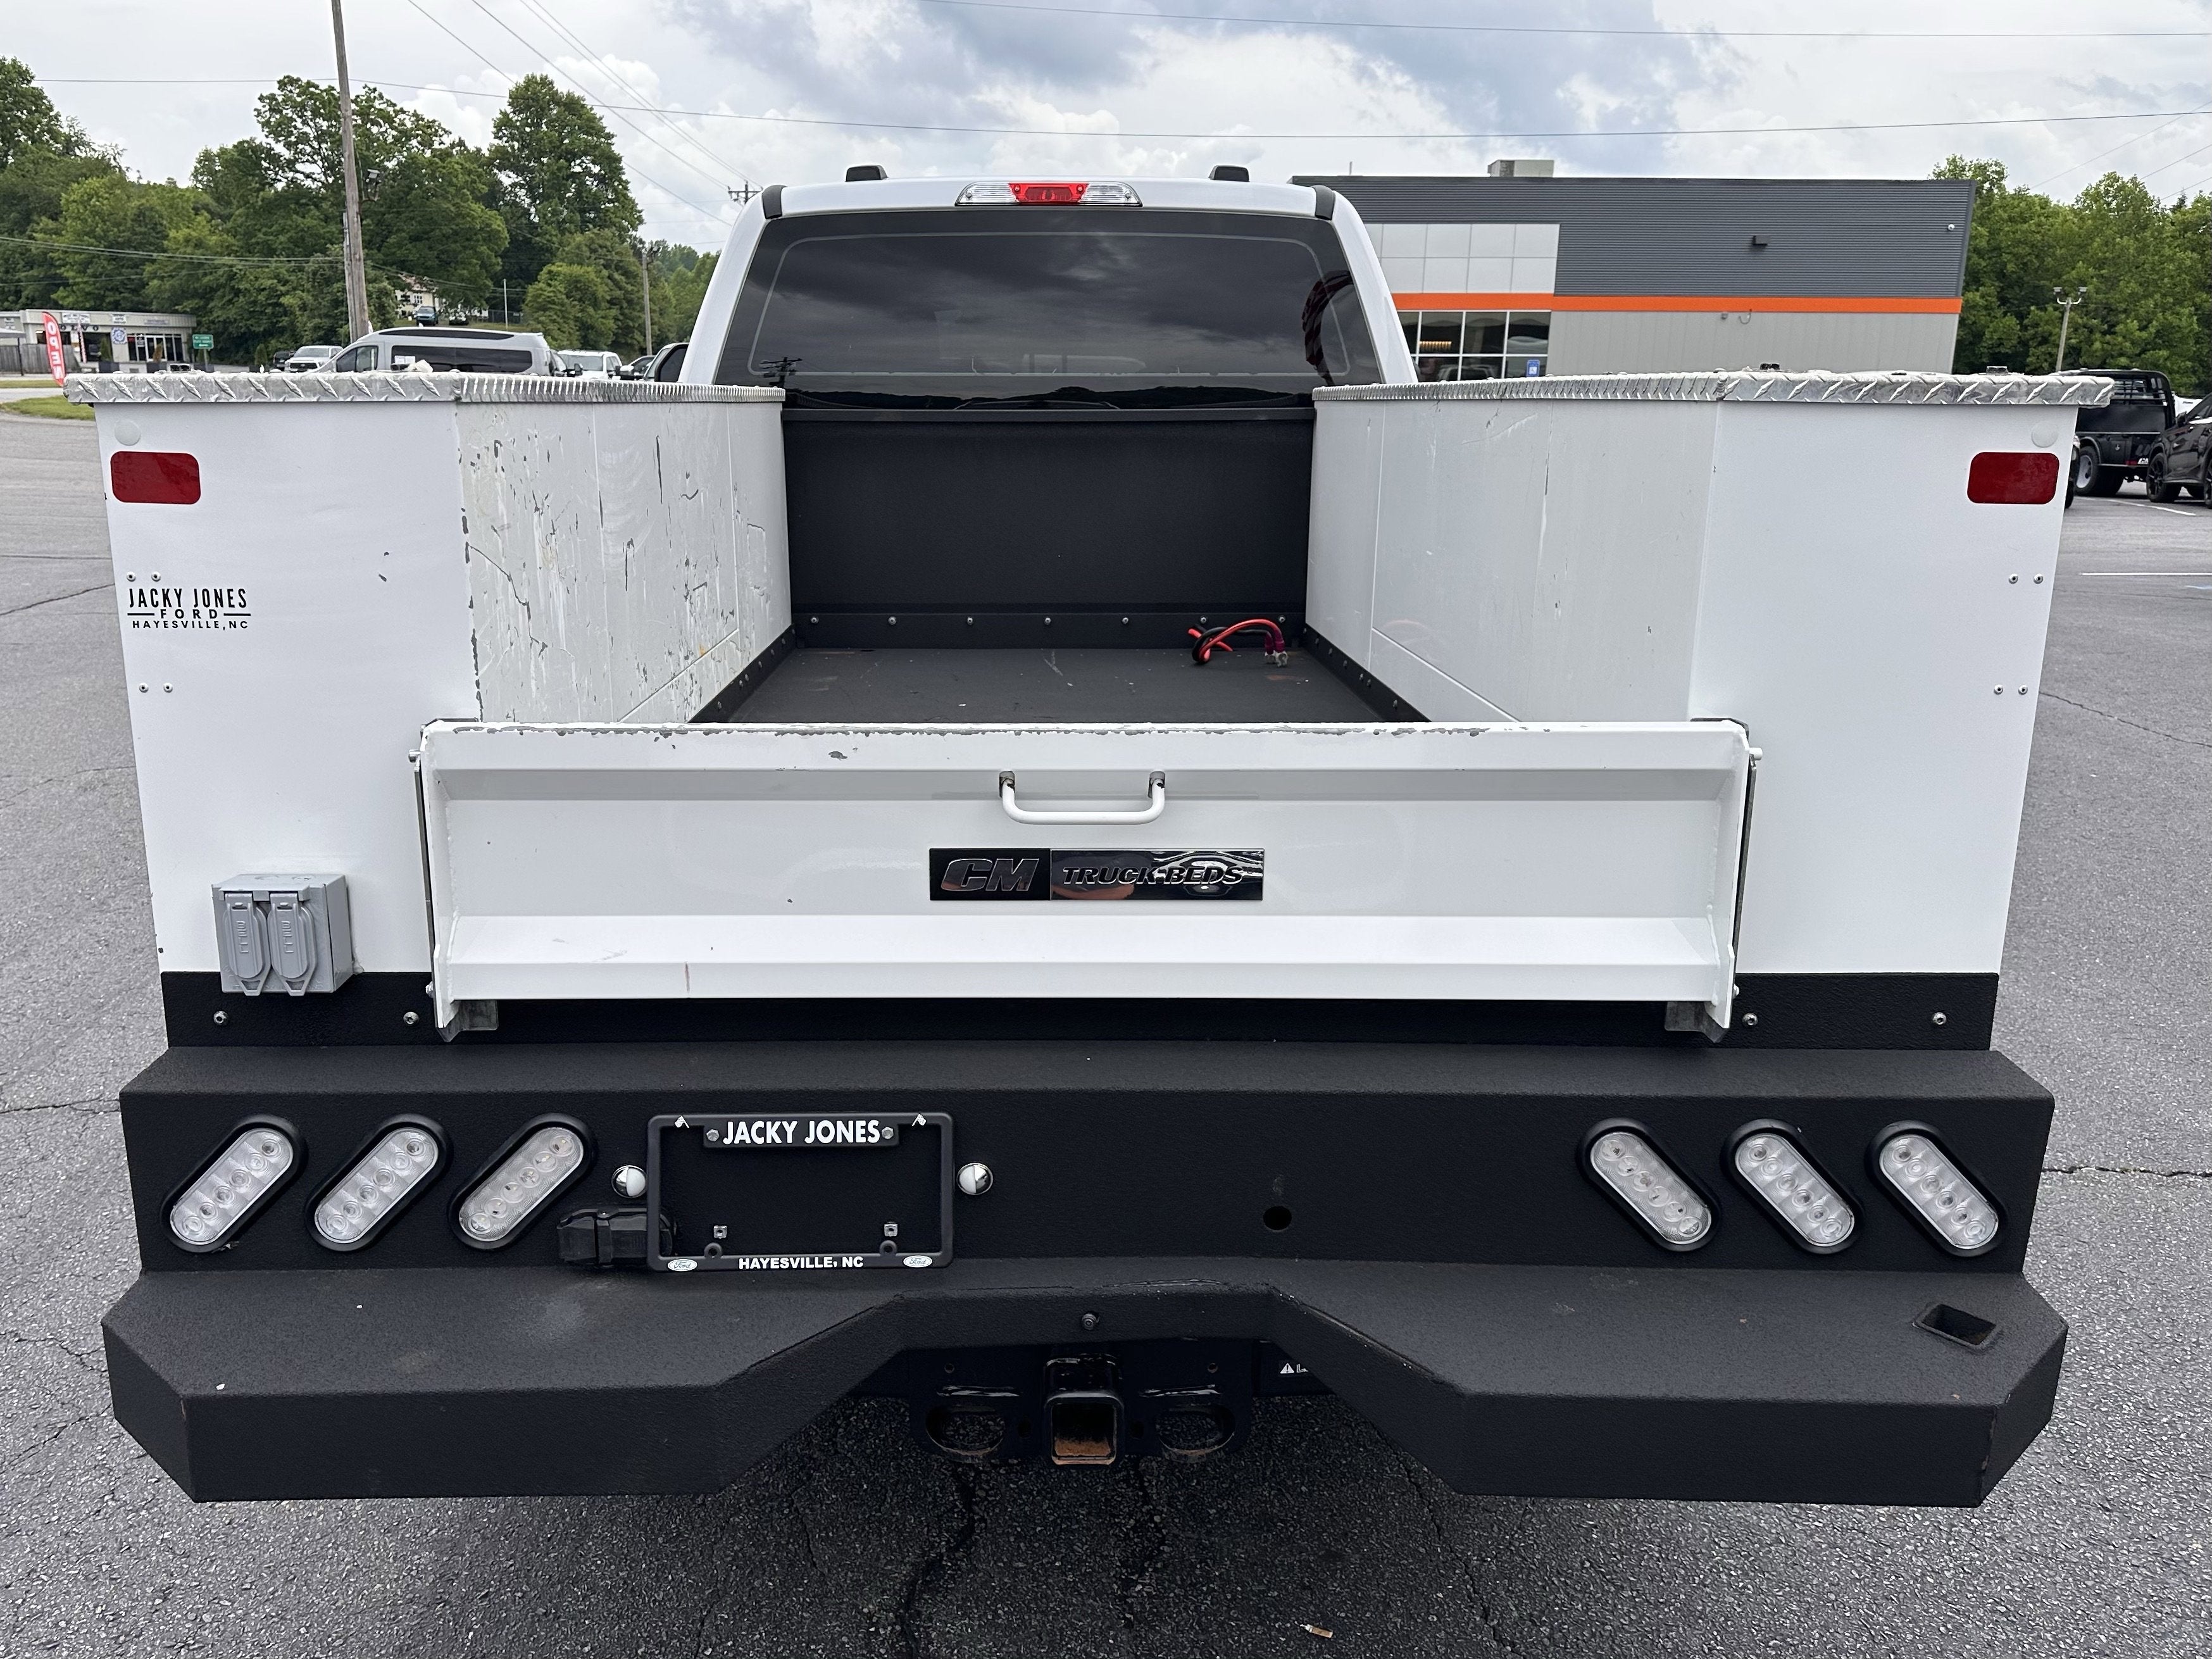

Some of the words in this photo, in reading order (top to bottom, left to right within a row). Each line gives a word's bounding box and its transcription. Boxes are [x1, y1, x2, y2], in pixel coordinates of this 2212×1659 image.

[129, 588, 182, 608] JACKY
[194, 588, 247, 608] JONES
[160, 609, 218, 619] FORD
[941, 858, 1039, 891] CM
[1063, 867, 1158, 885] TRUCK
[1163, 867, 1244, 885] BEDS
[236, 920, 249, 953] BELL
[281, 920, 294, 953] BELL
[723, 1120, 798, 1144] JACKY
[804, 1120, 880, 1144] JONES
[739, 1256, 838, 1269] HAYESVILLE,
[842, 1256, 864, 1268] NC
